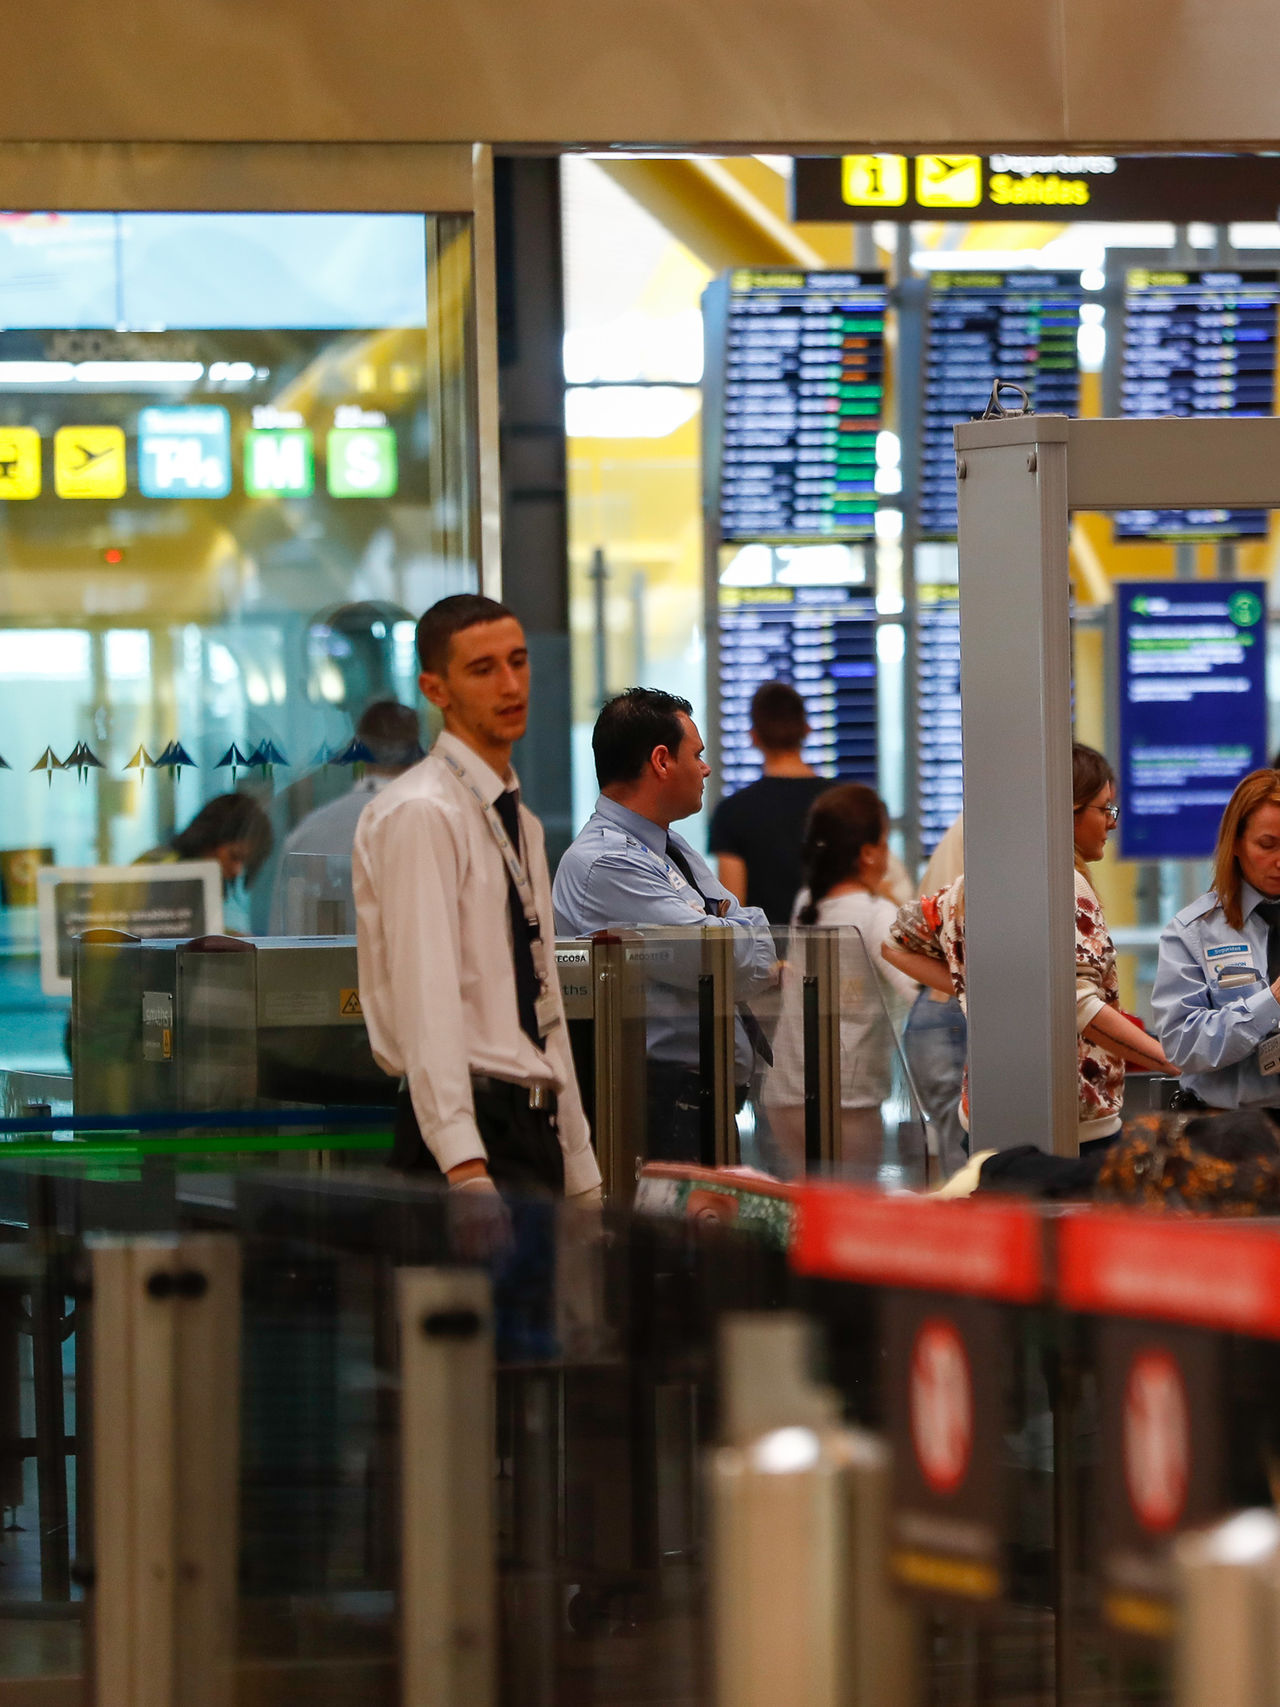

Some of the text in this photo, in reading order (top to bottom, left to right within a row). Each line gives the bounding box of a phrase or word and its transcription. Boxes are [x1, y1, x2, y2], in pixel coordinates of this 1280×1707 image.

[989, 173, 1090, 206] Salidas
[253, 436, 305, 489] M
[344, 435, 382, 488] S
[562, 984, 588, 995] ths
